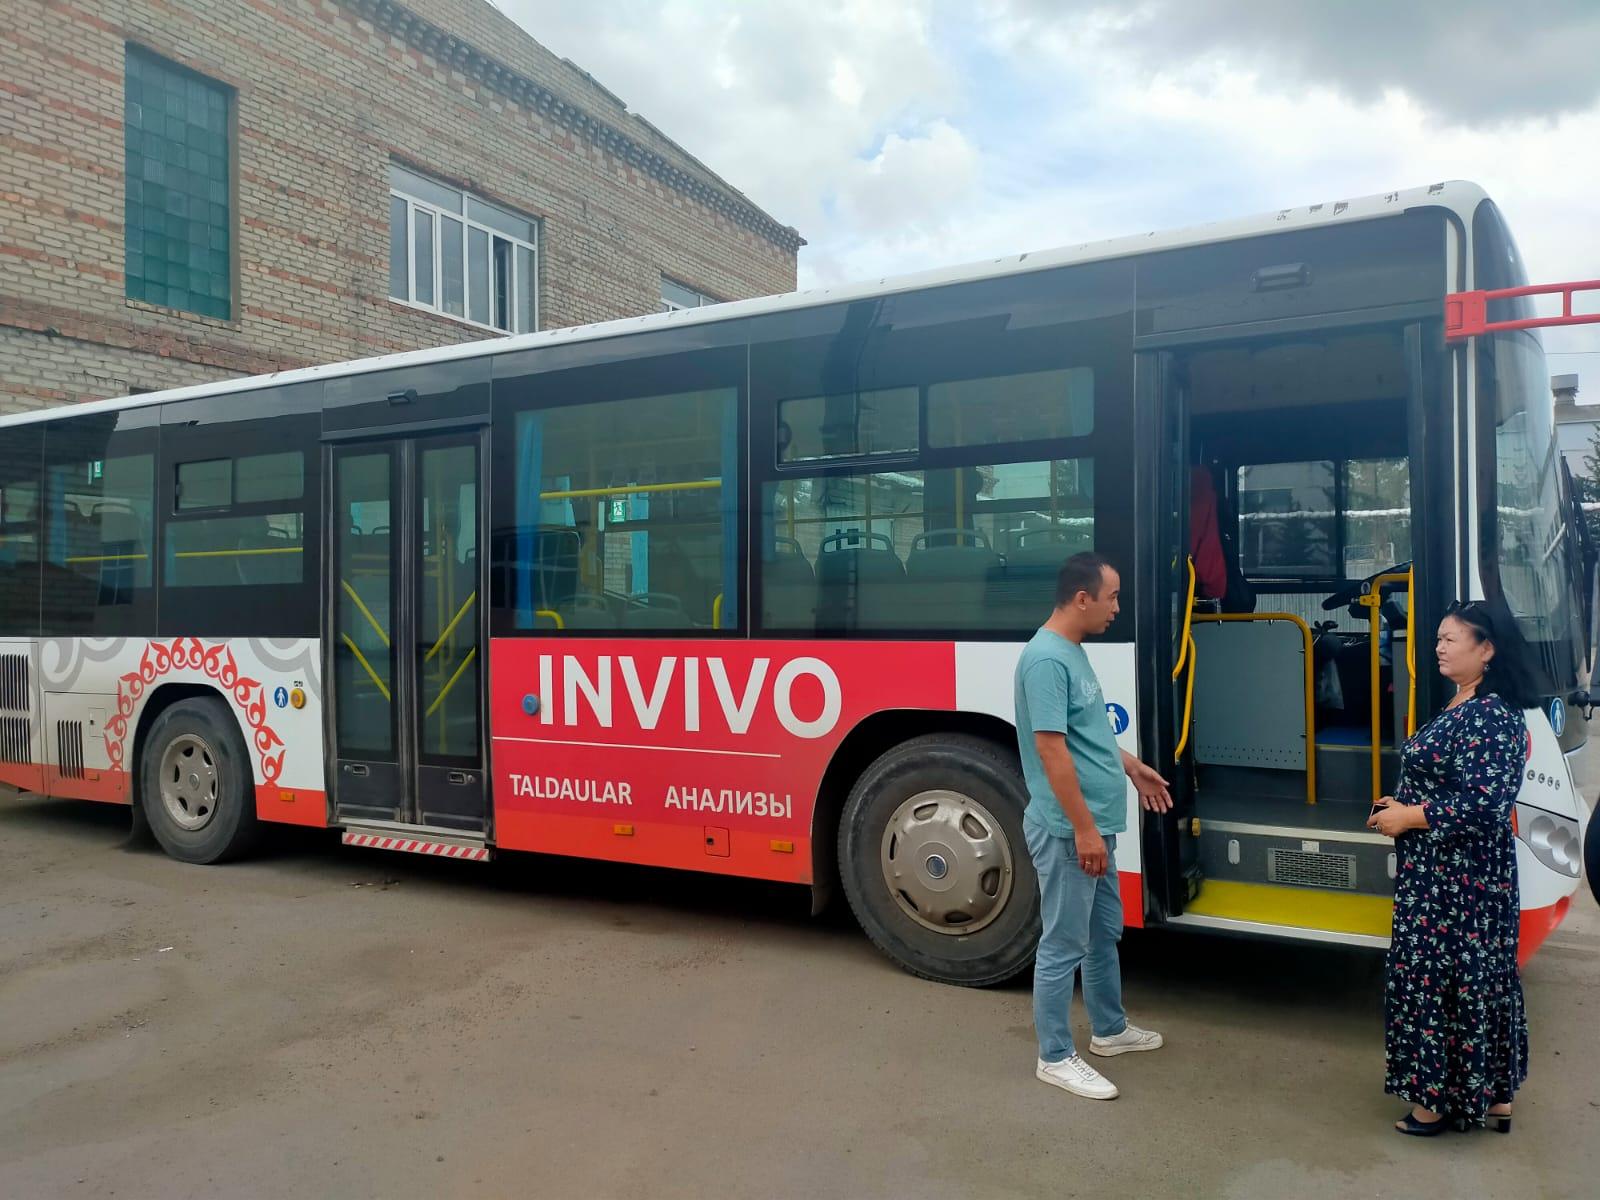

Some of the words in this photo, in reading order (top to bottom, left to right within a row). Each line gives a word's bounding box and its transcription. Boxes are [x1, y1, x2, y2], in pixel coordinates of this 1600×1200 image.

[539, 654, 842, 739] INVIVO
[509, 773, 633, 805] TALDAULAR
[664, 785, 792, 819] АНАЛИЗЫ
